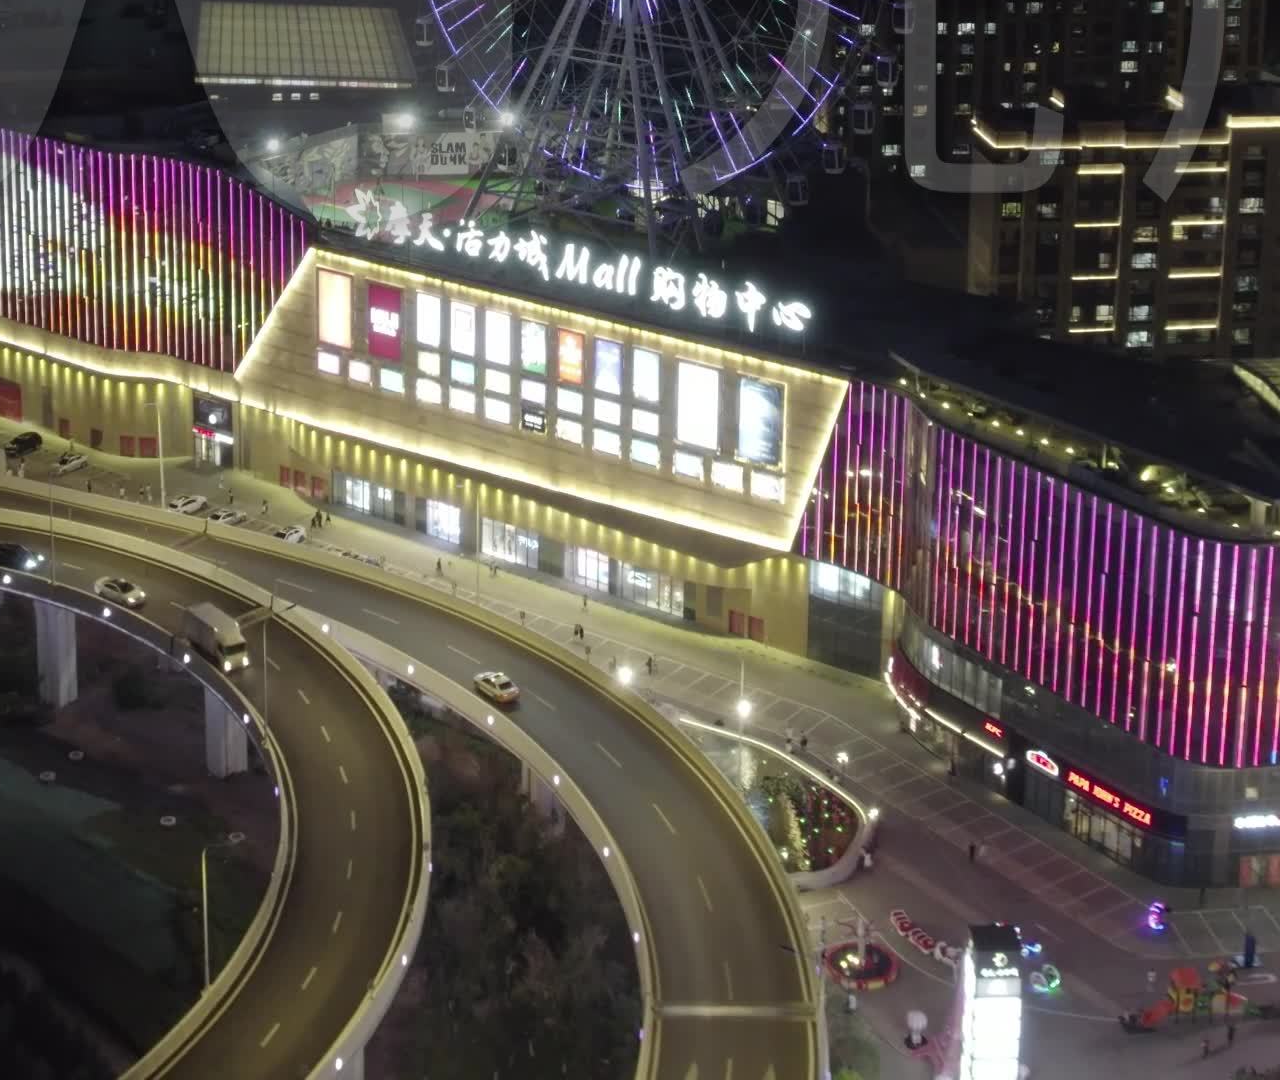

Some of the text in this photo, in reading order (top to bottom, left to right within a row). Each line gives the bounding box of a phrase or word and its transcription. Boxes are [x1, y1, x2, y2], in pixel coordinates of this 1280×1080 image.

[430, 142, 467, 154] SLAM
[556, 243, 641, 296] Mall
[650, 265, 812, 332] 购物中心
[1068, 771, 1090, 792] PAPA
[1123, 801, 1152, 825] PIZZA
